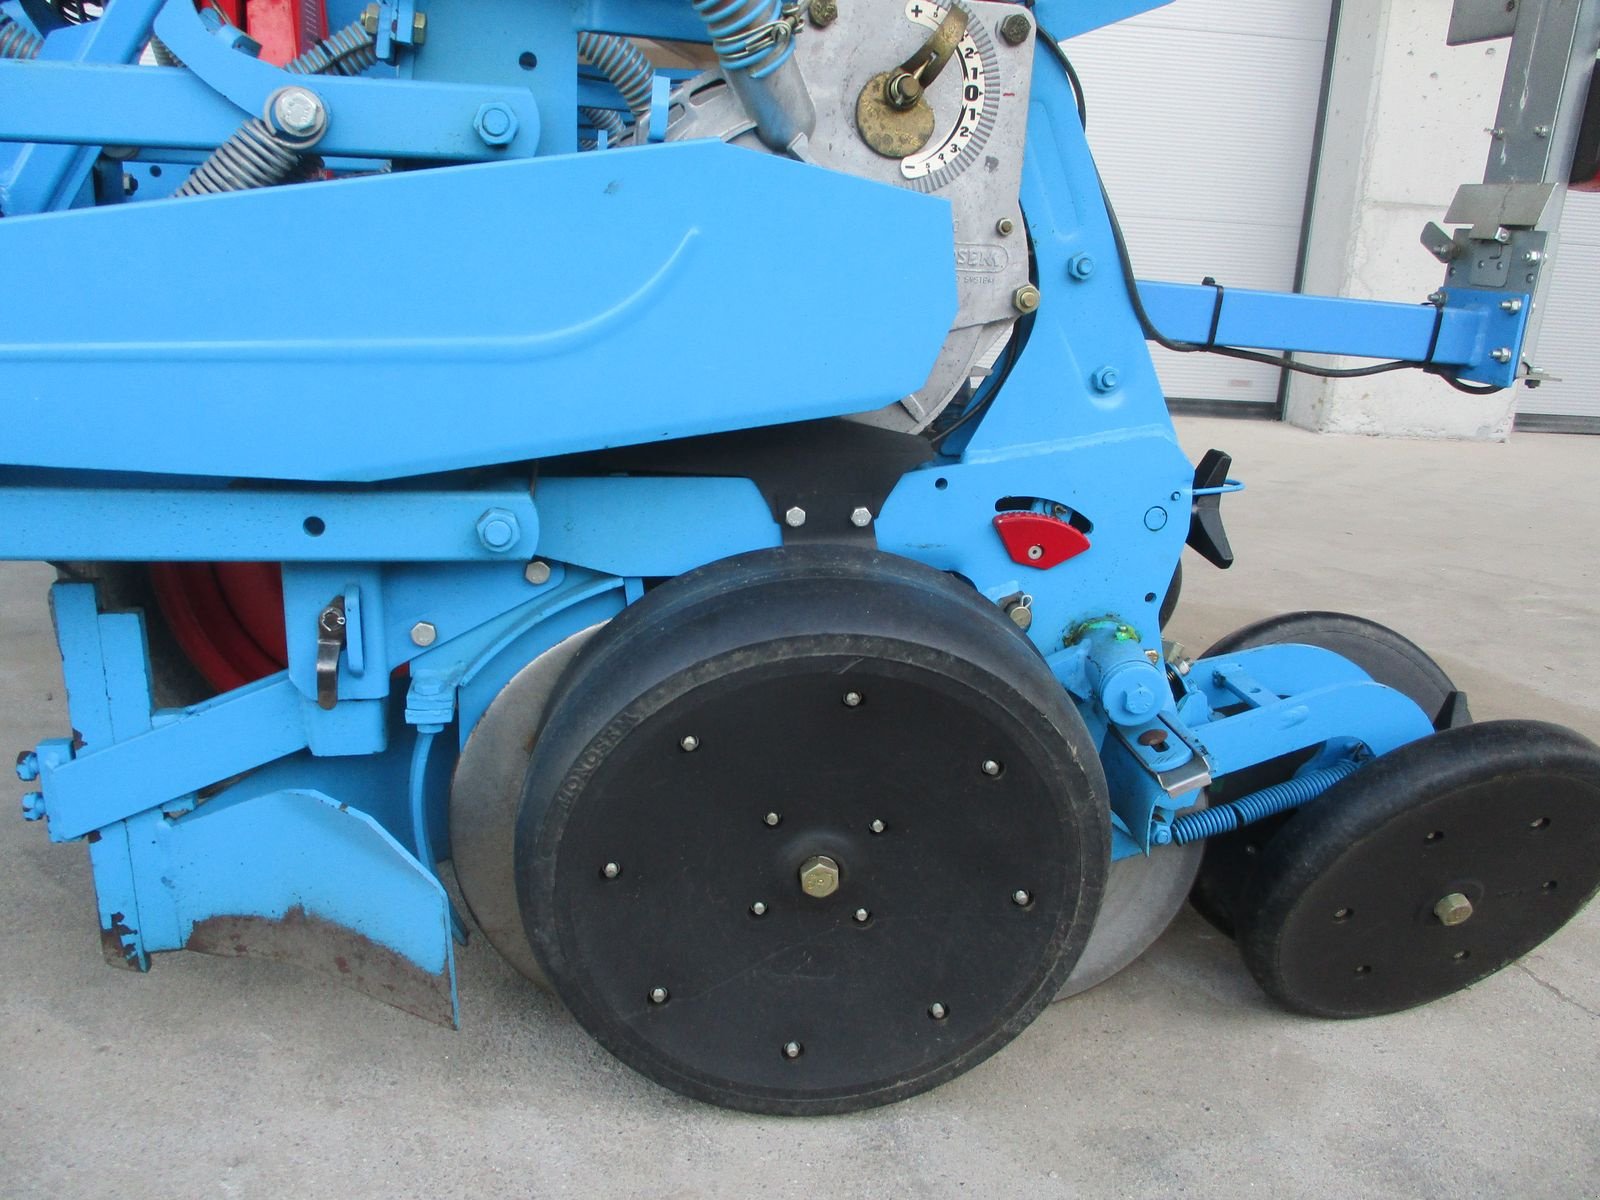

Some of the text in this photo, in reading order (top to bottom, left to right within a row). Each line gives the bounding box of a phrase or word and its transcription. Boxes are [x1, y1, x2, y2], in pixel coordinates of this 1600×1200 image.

[964, 47, 975, 59] 2
[970, 67, 979, 80] 1
[964, 84, 979, 102] 0
[968, 108, 976, 121] 1
[959, 126, 970, 138] 2
[950, 144, 958, 153] 3
[937, 153, 945, 161] 4
